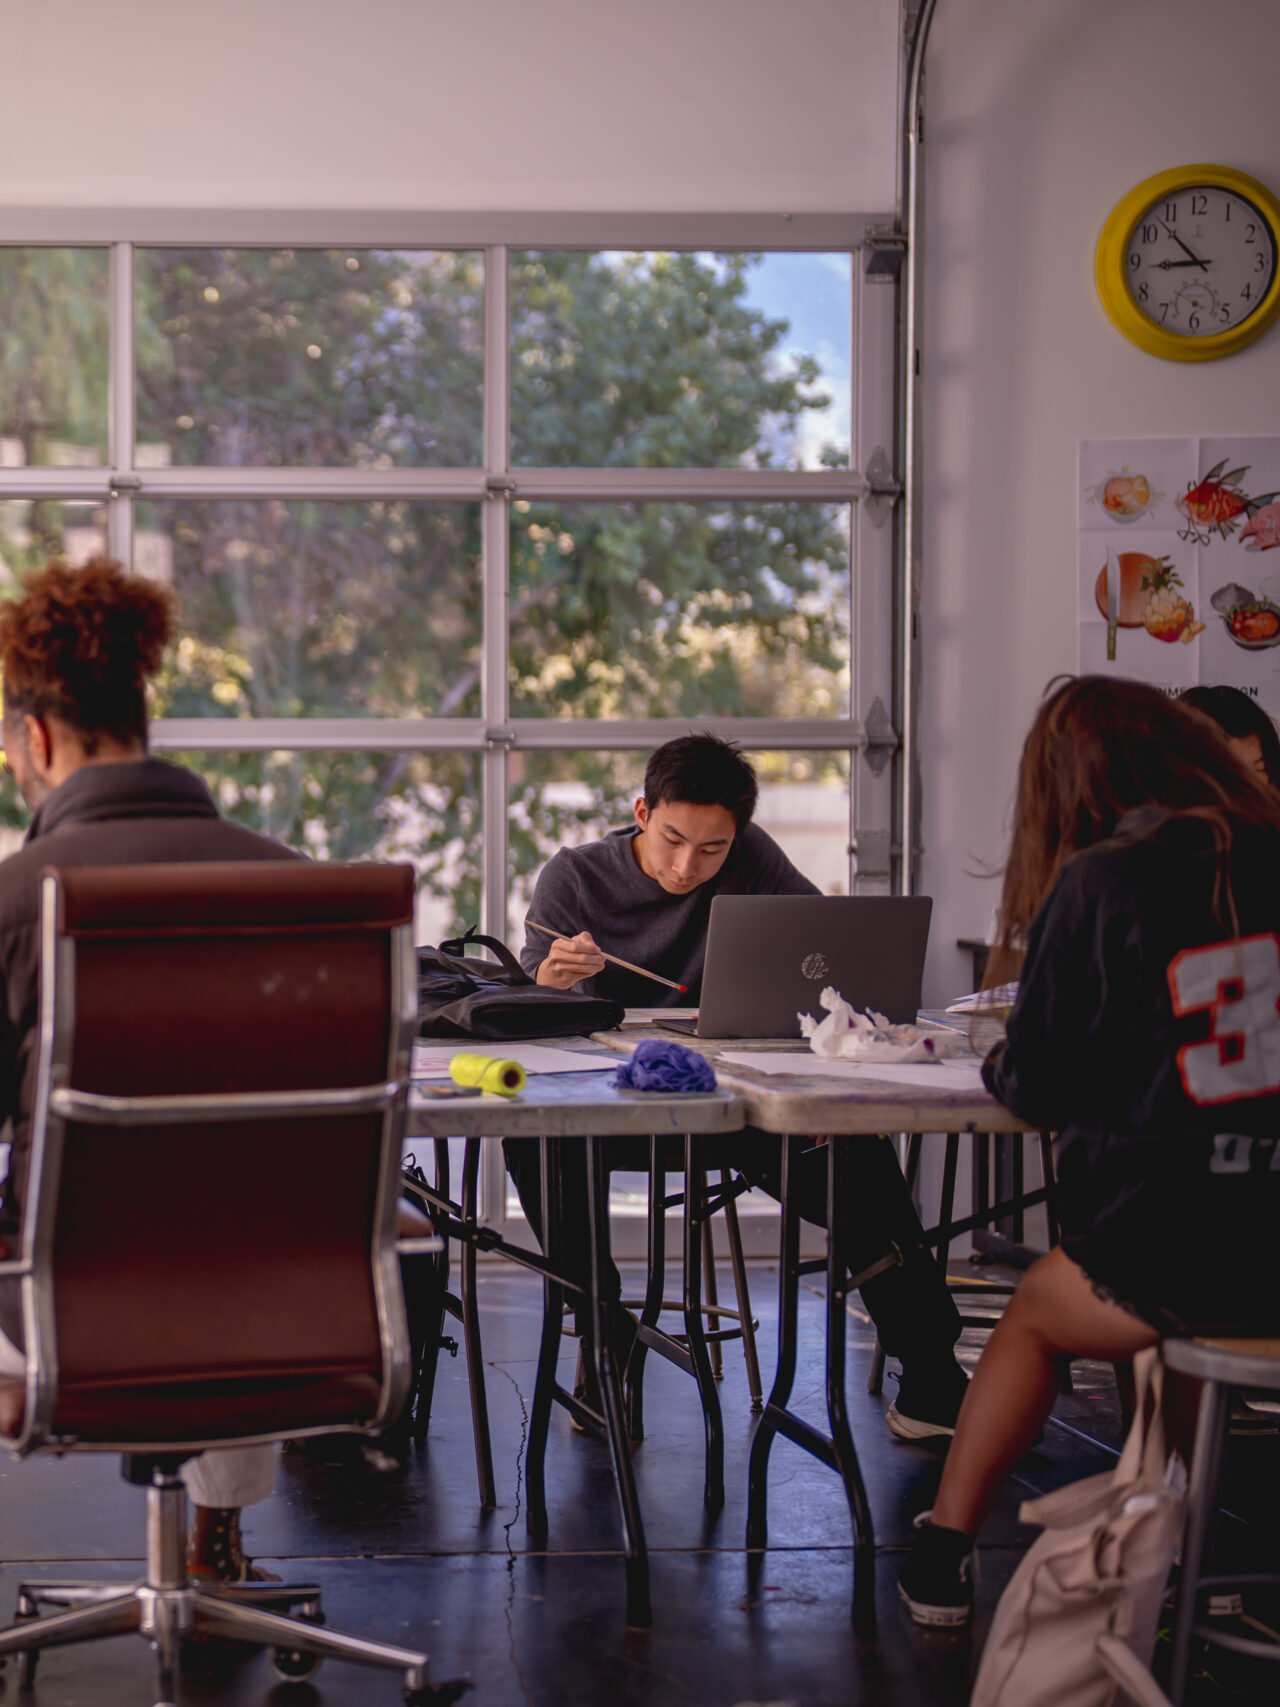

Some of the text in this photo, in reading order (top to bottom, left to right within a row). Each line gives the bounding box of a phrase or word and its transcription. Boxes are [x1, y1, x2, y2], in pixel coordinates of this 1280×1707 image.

[1165, 203, 1178, 222] 11
[1192, 195, 1208, 216] 12
[1225, 203, 1232, 222] 1
[1142, 224, 1158, 244] 10
[1244, 224, 1256, 244] 2
[1130, 253, 1142, 272] 9
[1254, 253, 1265, 273] 3
[1138, 282, 1149, 301] 8
[1240, 282, 1252, 301] 4
[1158, 303, 1169, 323] 7
[1188, 312, 1200, 330] 6
[1219, 303, 1231, 323] 5
[1167, 931, 1280, 1107] 3
